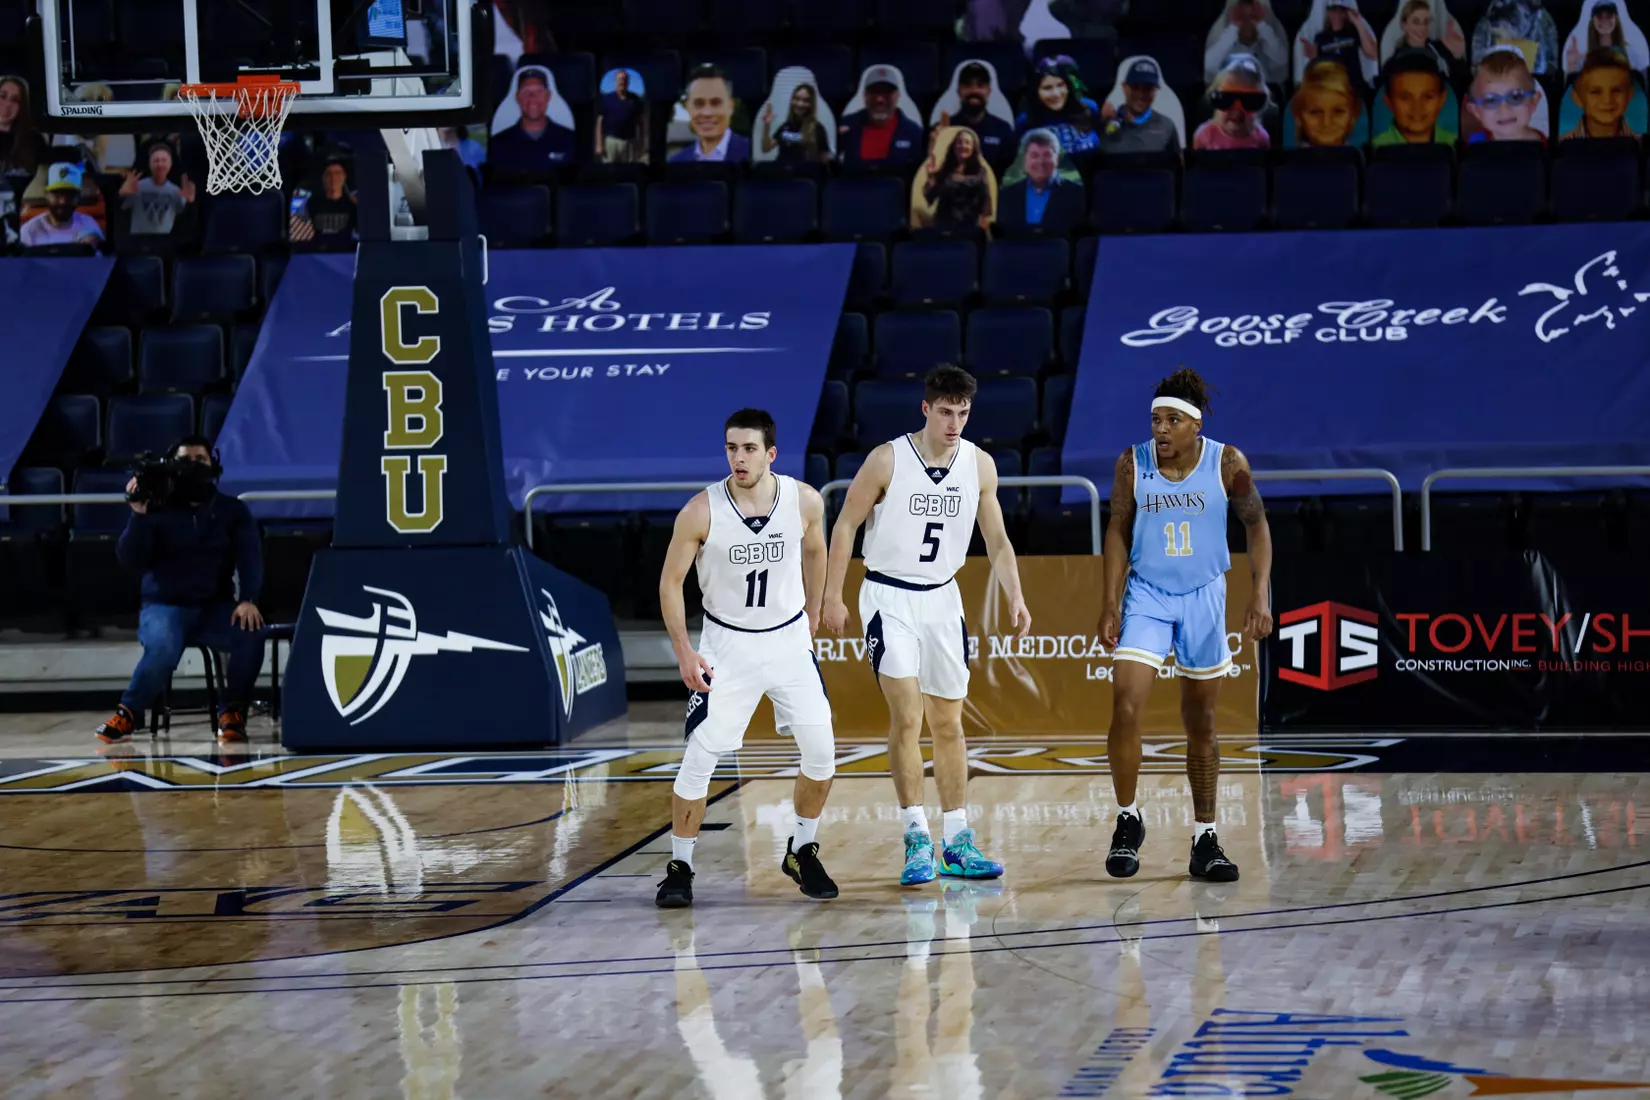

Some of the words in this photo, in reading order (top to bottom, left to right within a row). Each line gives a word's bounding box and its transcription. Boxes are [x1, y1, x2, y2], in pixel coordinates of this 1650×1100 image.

[61, 106, 103, 116] SPALDING
[537, 311, 771, 333] HOTELS
[1120, 306, 1313, 347] Goose
[1317, 298, 1507, 329] Creek
[1214, 328, 1303, 347] GOLF
[1315, 325, 1408, 343] CLUB
[523, 366, 594, 381] YOUR
[606, 363, 671, 378] STAY
[380, 285, 448, 534] CBU
[908, 493, 962, 518] CBU
[1140, 491, 1206, 516] HAWKS
[918, 522, 945, 563] 5
[1163, 521, 1194, 557] 11
[729, 541, 785, 565] CBU
[745, 568, 769, 608] 11
[988, 634, 1116, 660] MEDICA
[1538, 660, 1611, 672] BUILDING
